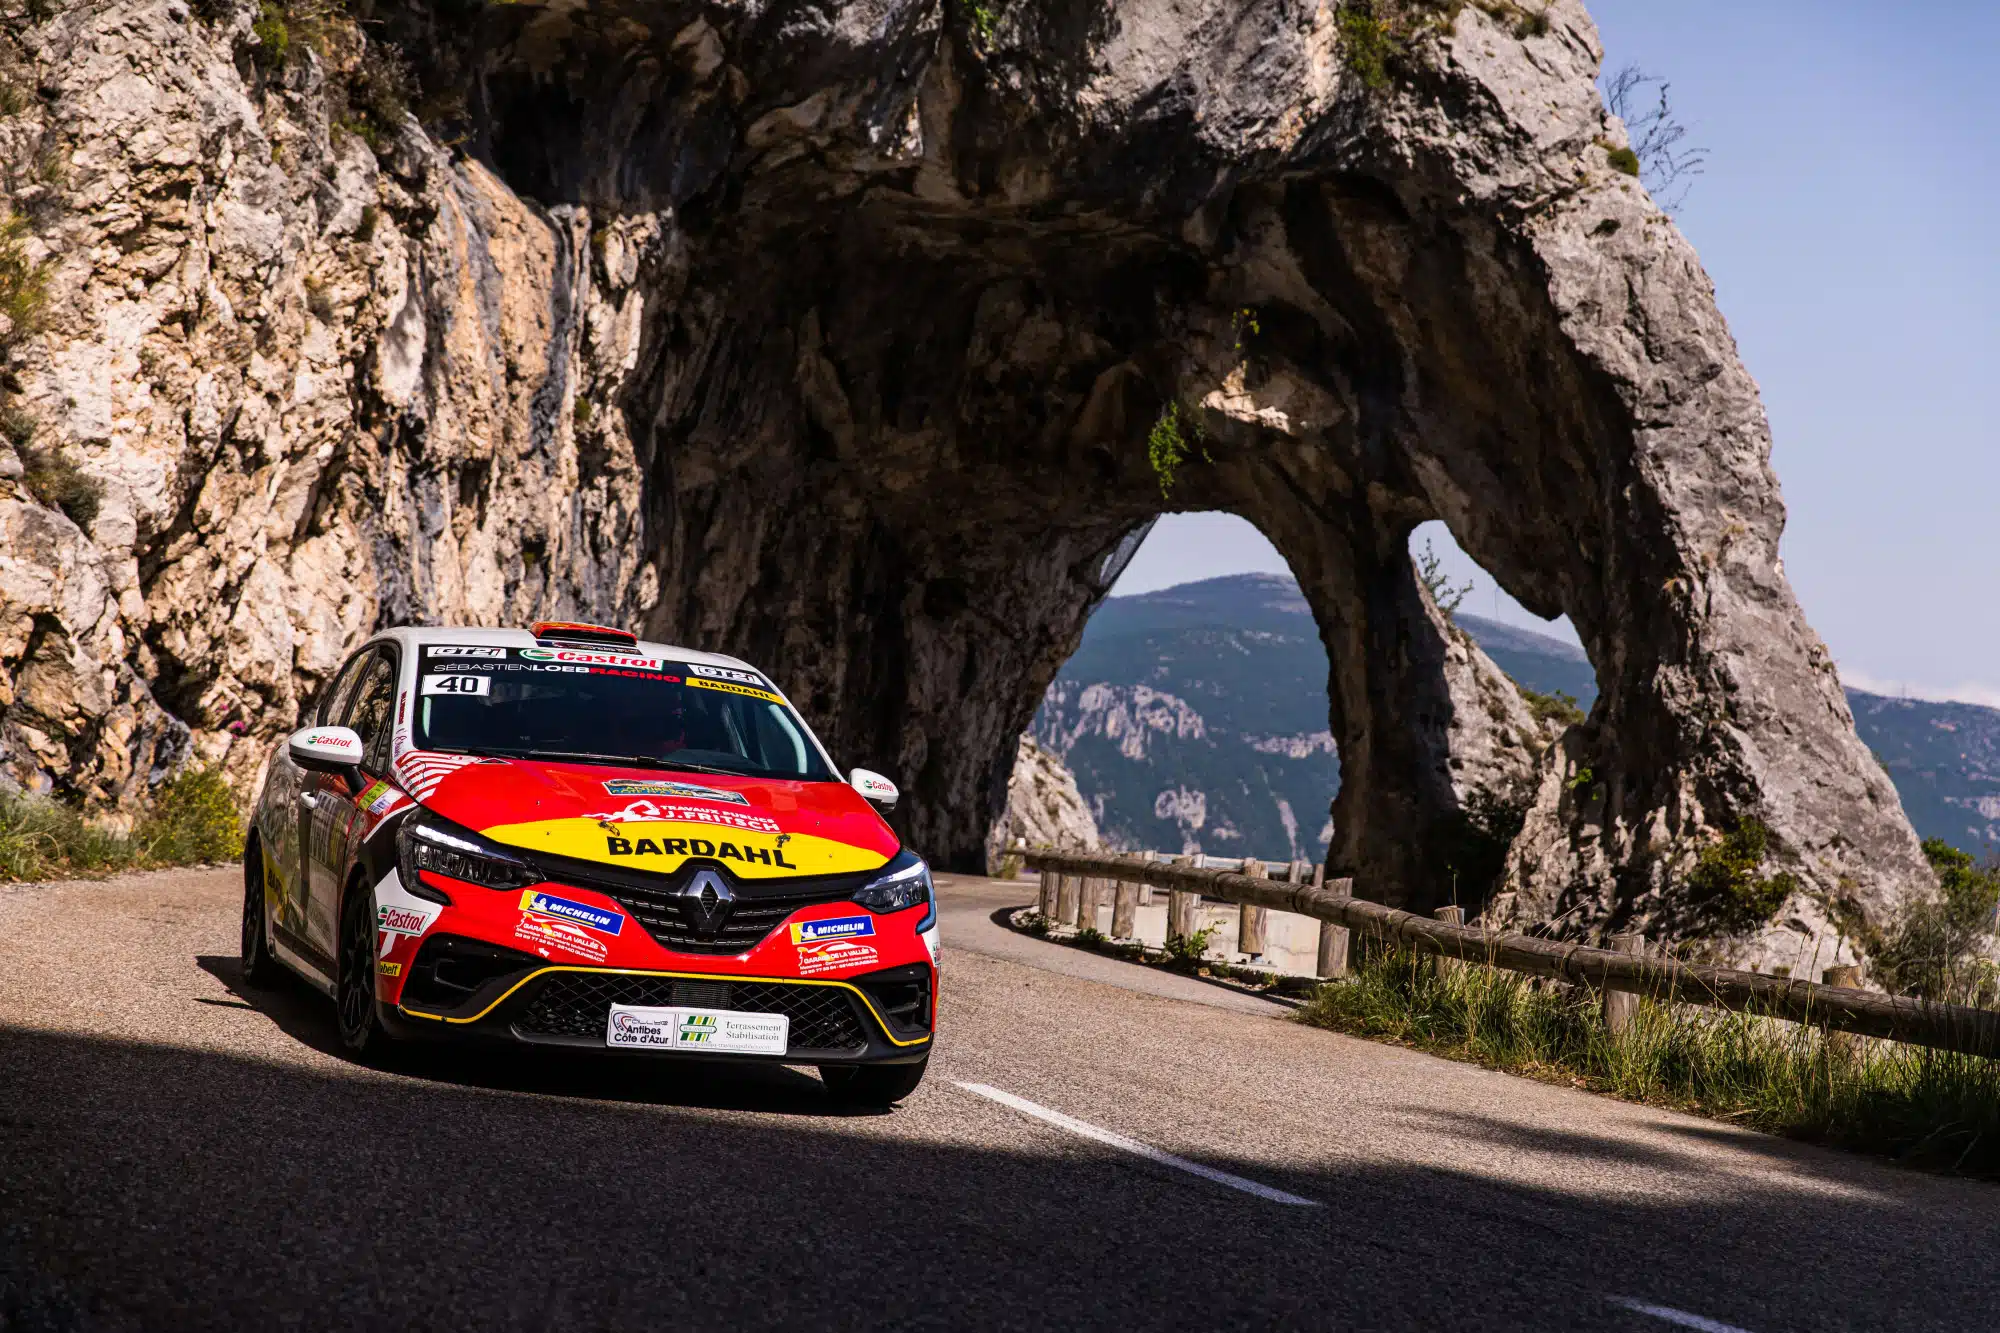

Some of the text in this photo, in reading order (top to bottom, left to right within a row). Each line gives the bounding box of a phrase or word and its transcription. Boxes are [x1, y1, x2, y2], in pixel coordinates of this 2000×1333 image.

[557, 651, 659, 669] Castrol
[436, 676, 479, 693] 40
[697, 680, 771, 700] BARDAHL
[316, 735, 353, 748] Castrol
[872, 780, 895, 792] Castrol
[660, 804, 720, 815] TRAVAUX
[607, 835, 796, 870] BARDAHL
[385, 909, 425, 932] Castrol
[549, 903, 611, 925] MICHELIN
[817, 922, 865, 935] MICHELIN
[627, 1025, 661, 1035] Antibes
[726, 1020, 781, 1031] Terrassement
[614, 1033, 668, 1044] Côte d'Azur
[726, 1031, 779, 1041] Stabilisation
